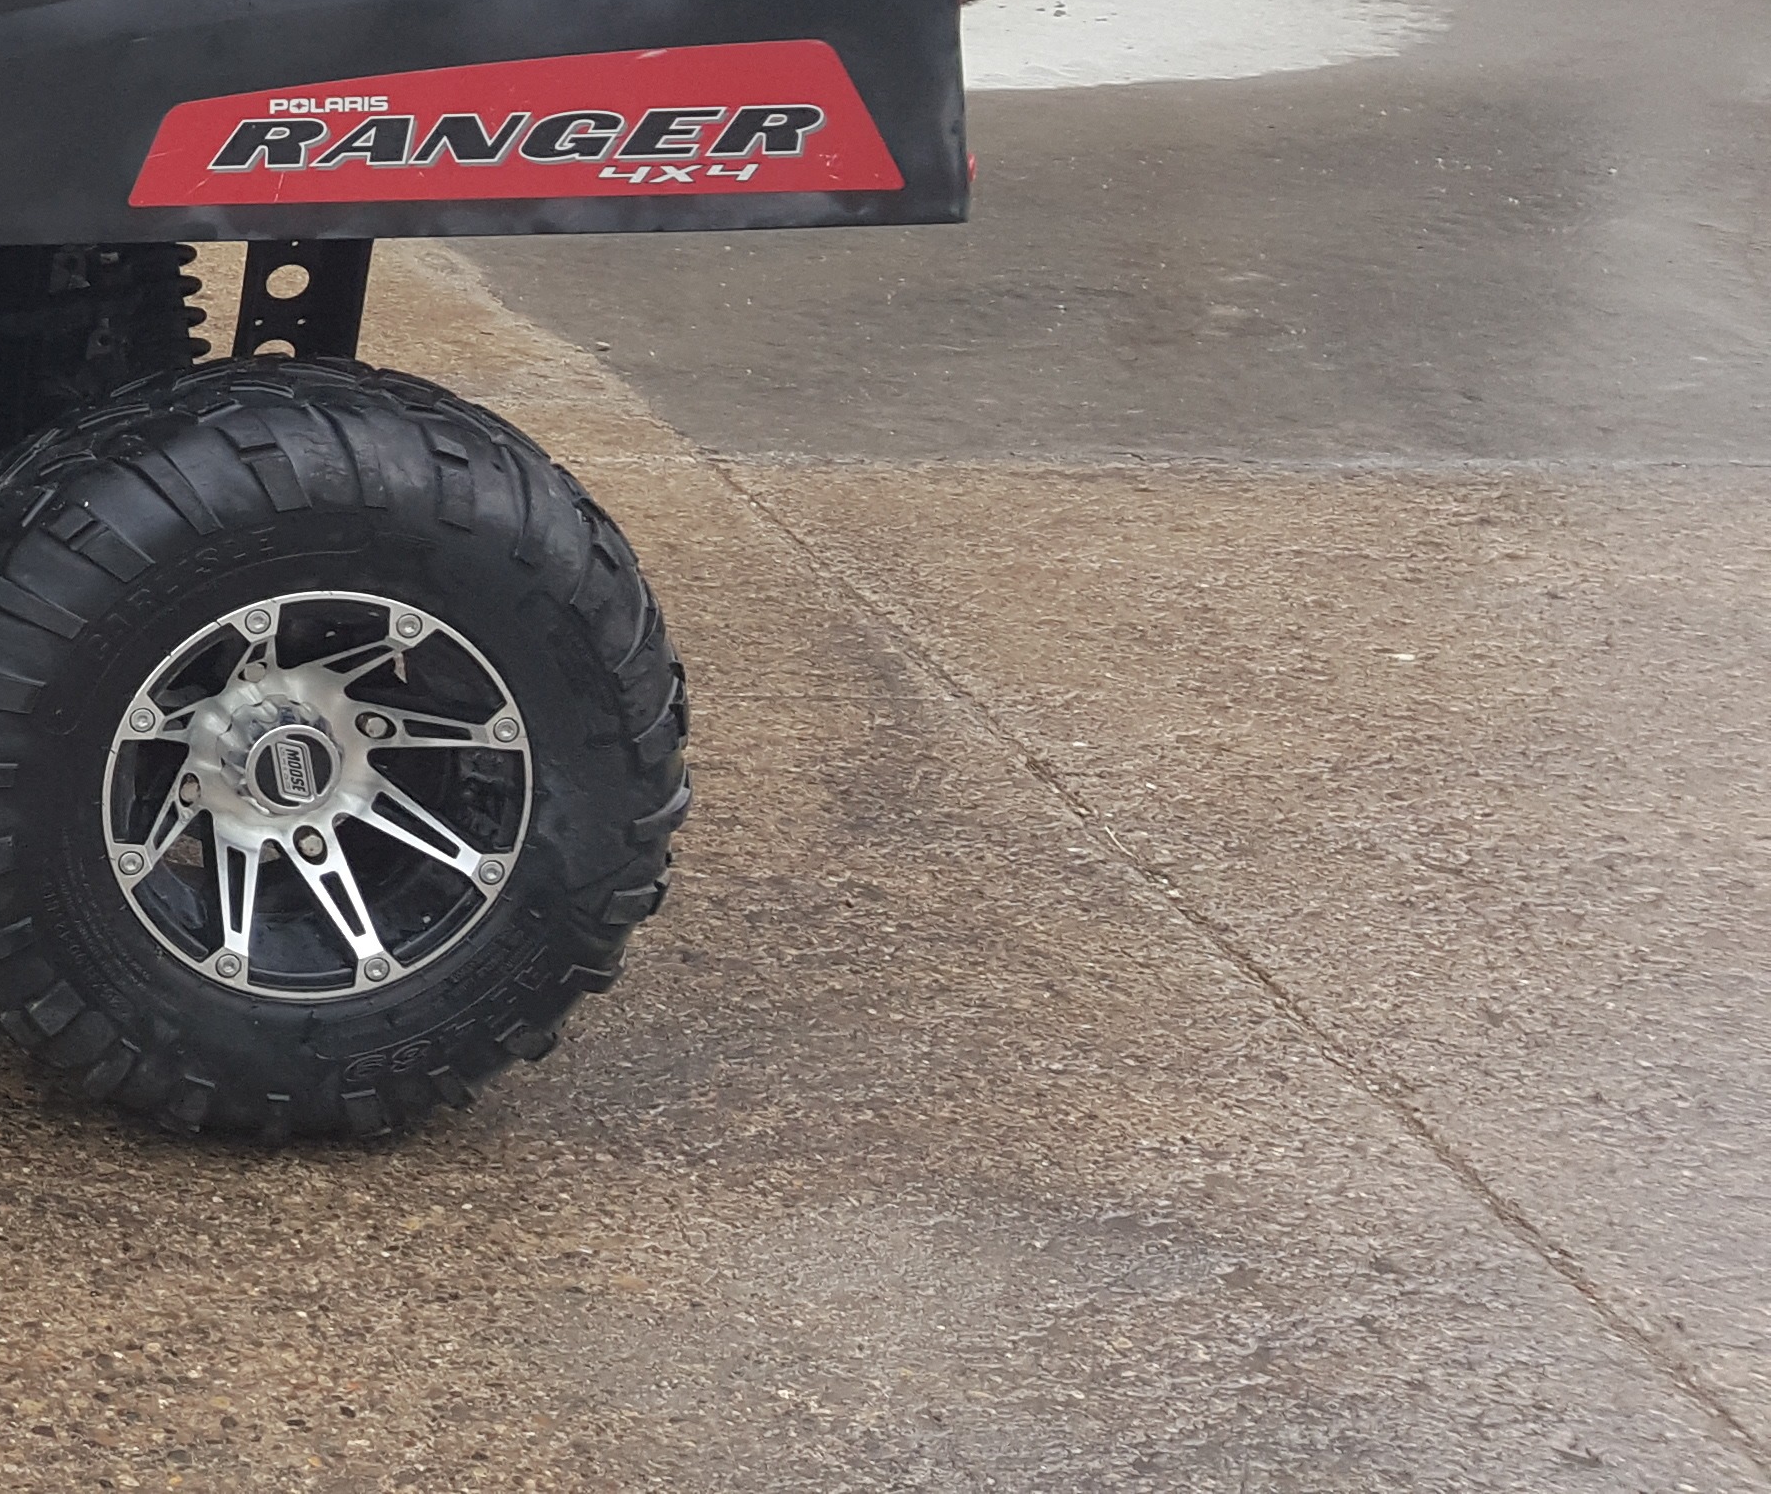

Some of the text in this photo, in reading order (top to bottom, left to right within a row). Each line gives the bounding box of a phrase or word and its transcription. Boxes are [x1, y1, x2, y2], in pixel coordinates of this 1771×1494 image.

[268, 96, 389, 114] POLARIS
[206, 104, 830, 172] RANGER
[285, 748, 306, 793] MOOSE
